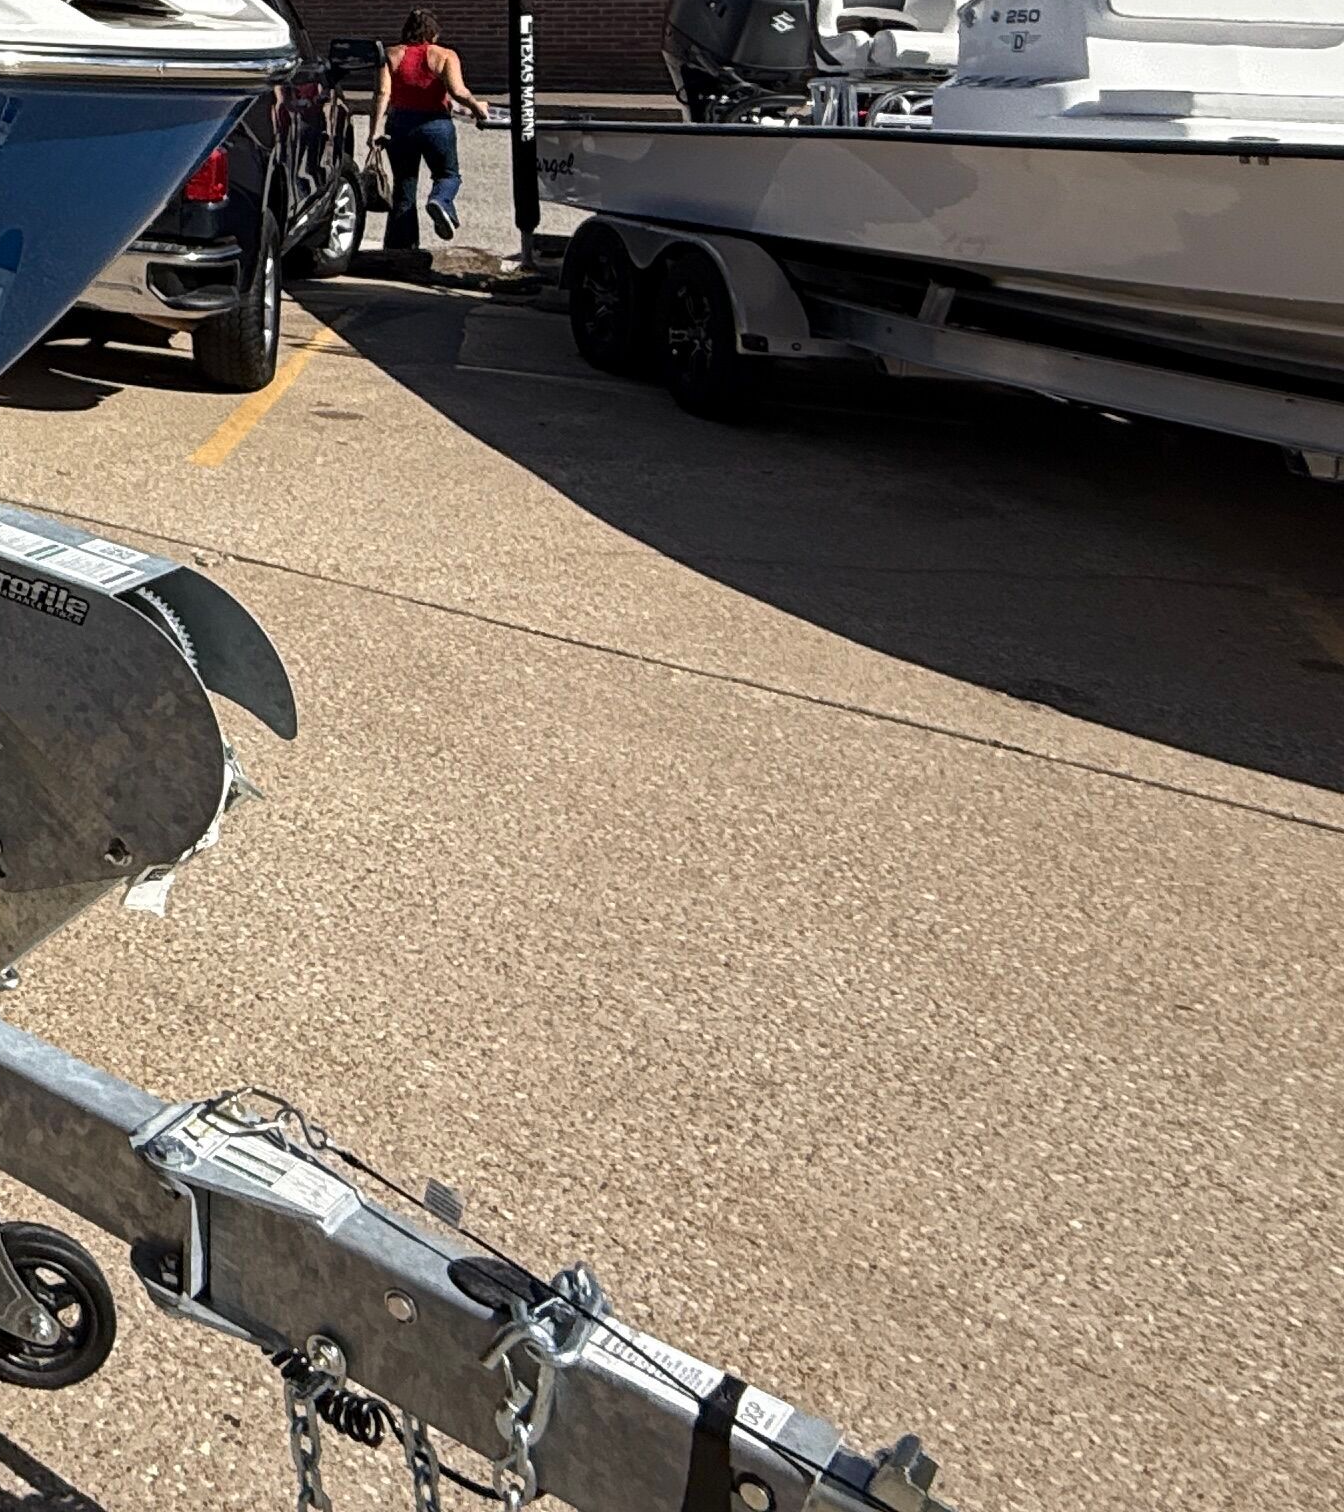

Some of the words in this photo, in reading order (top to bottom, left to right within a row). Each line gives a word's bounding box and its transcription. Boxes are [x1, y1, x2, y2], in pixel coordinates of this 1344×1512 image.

[1006, 9, 1040, 24] 250
[520, 34, 535, 83] TEXAS
[536, 152, 574, 181] argel
